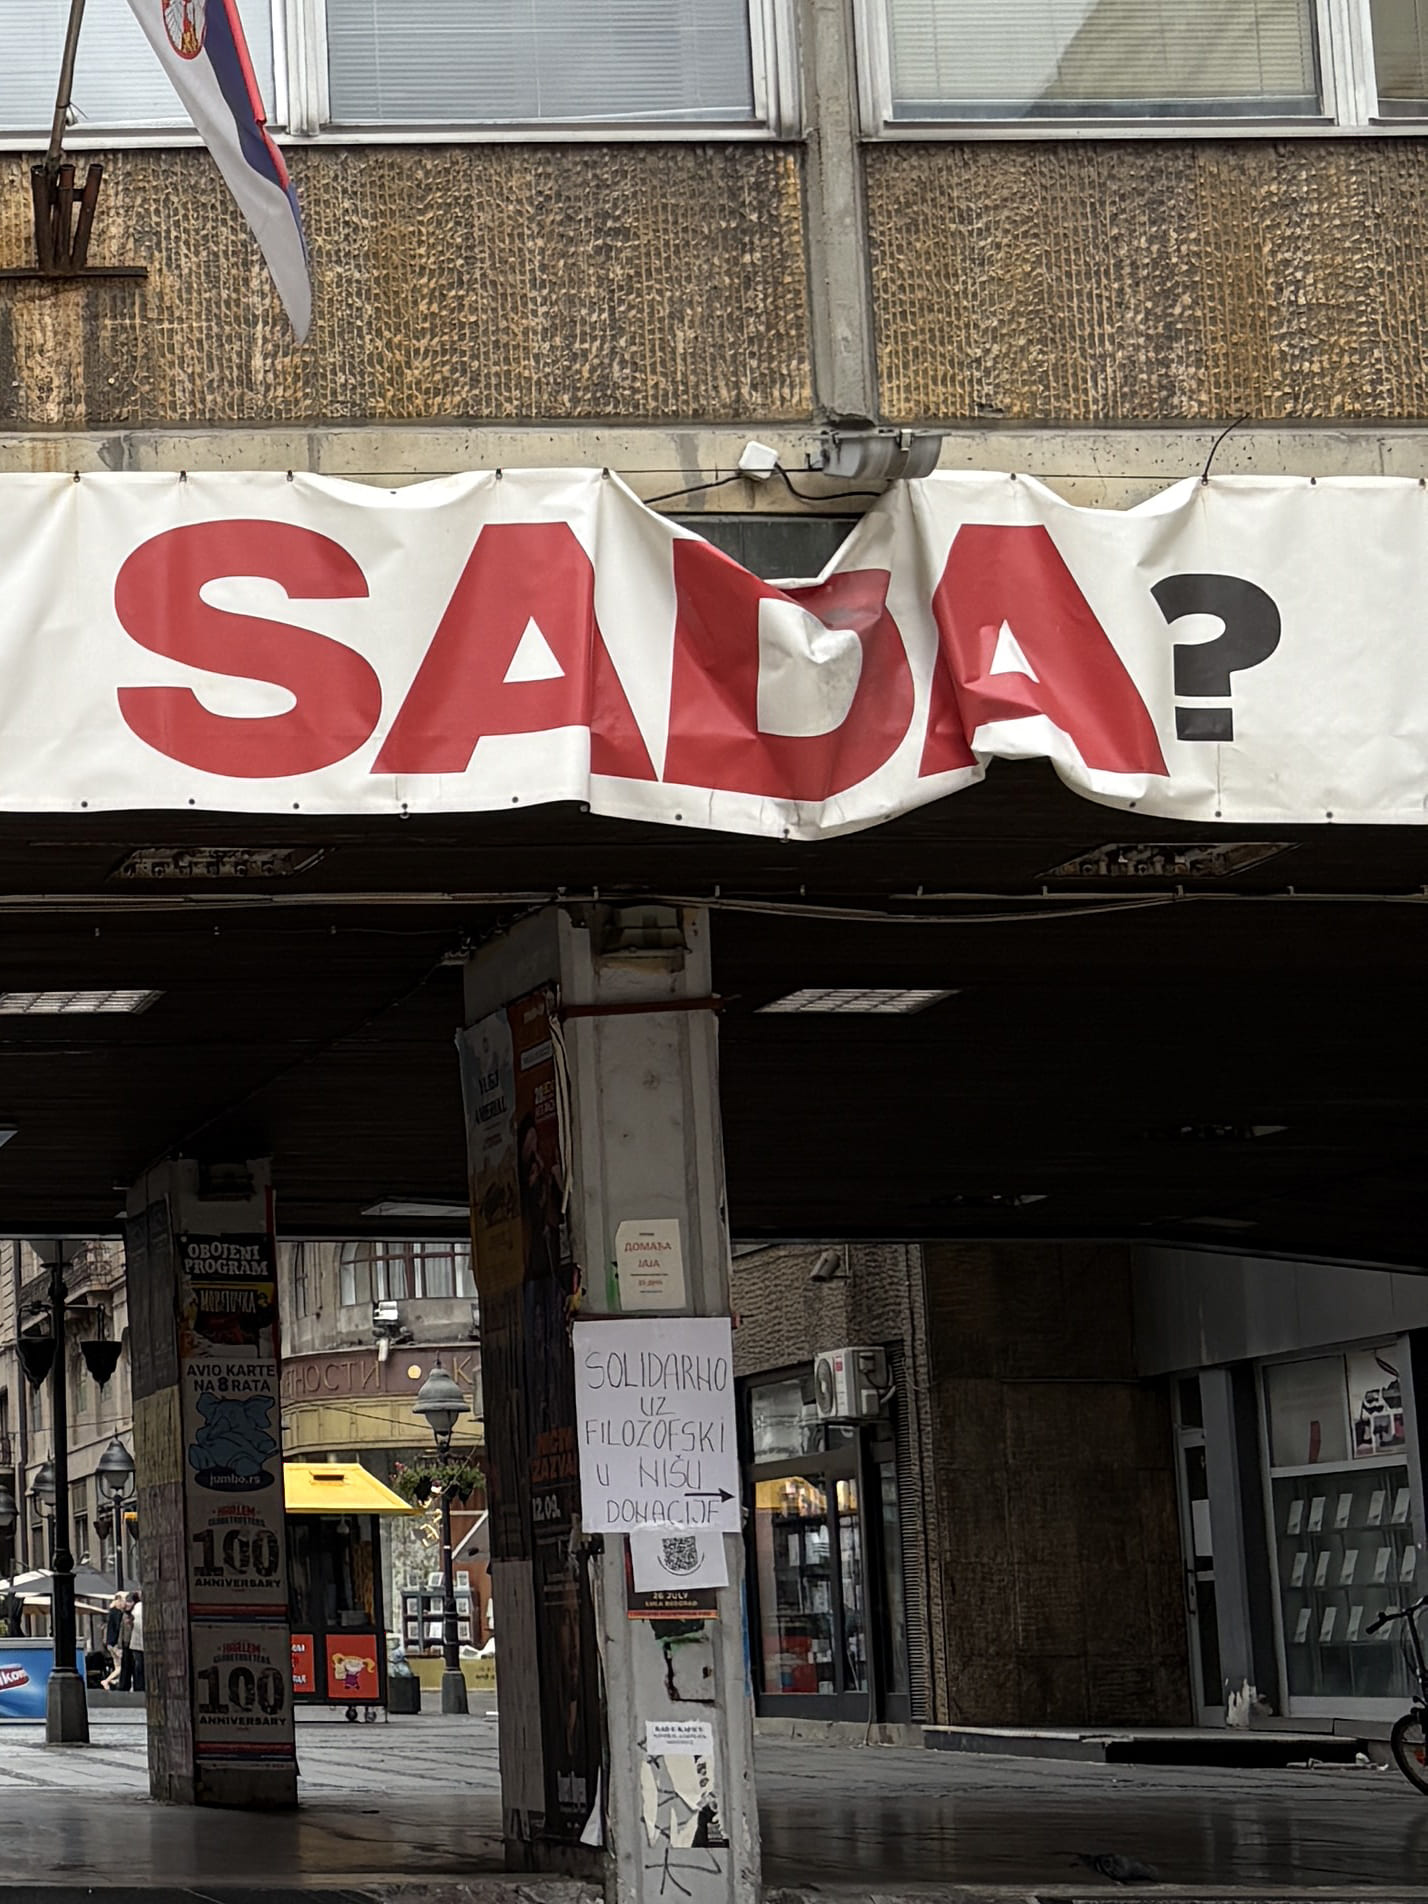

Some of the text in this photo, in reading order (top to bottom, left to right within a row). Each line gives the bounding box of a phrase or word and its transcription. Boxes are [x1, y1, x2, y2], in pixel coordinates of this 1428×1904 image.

[114, 516, 1283, 802] SADA?
[187, 1241, 261, 1261] OBOJENI
[183, 1257, 270, 1276] PROGRAM
[187, 1363, 276, 1377] AVIO KARTE
[584, 1351, 728, 1393] SOLIDARNO
[194, 1377, 271, 1392] NA 8 RATA
[640, 1396, 677, 1417] UZ
[208, 1472, 263, 1487] jumbo.rs
[639, 1454, 702, 1490] NIŠU
[192, 1528, 280, 1577] 100
[194, 1577, 282, 1589] ANNIVERSARY
[197, 1666, 285, 1715] 100
[199, 1715, 287, 1727] ANNIVERSARY
